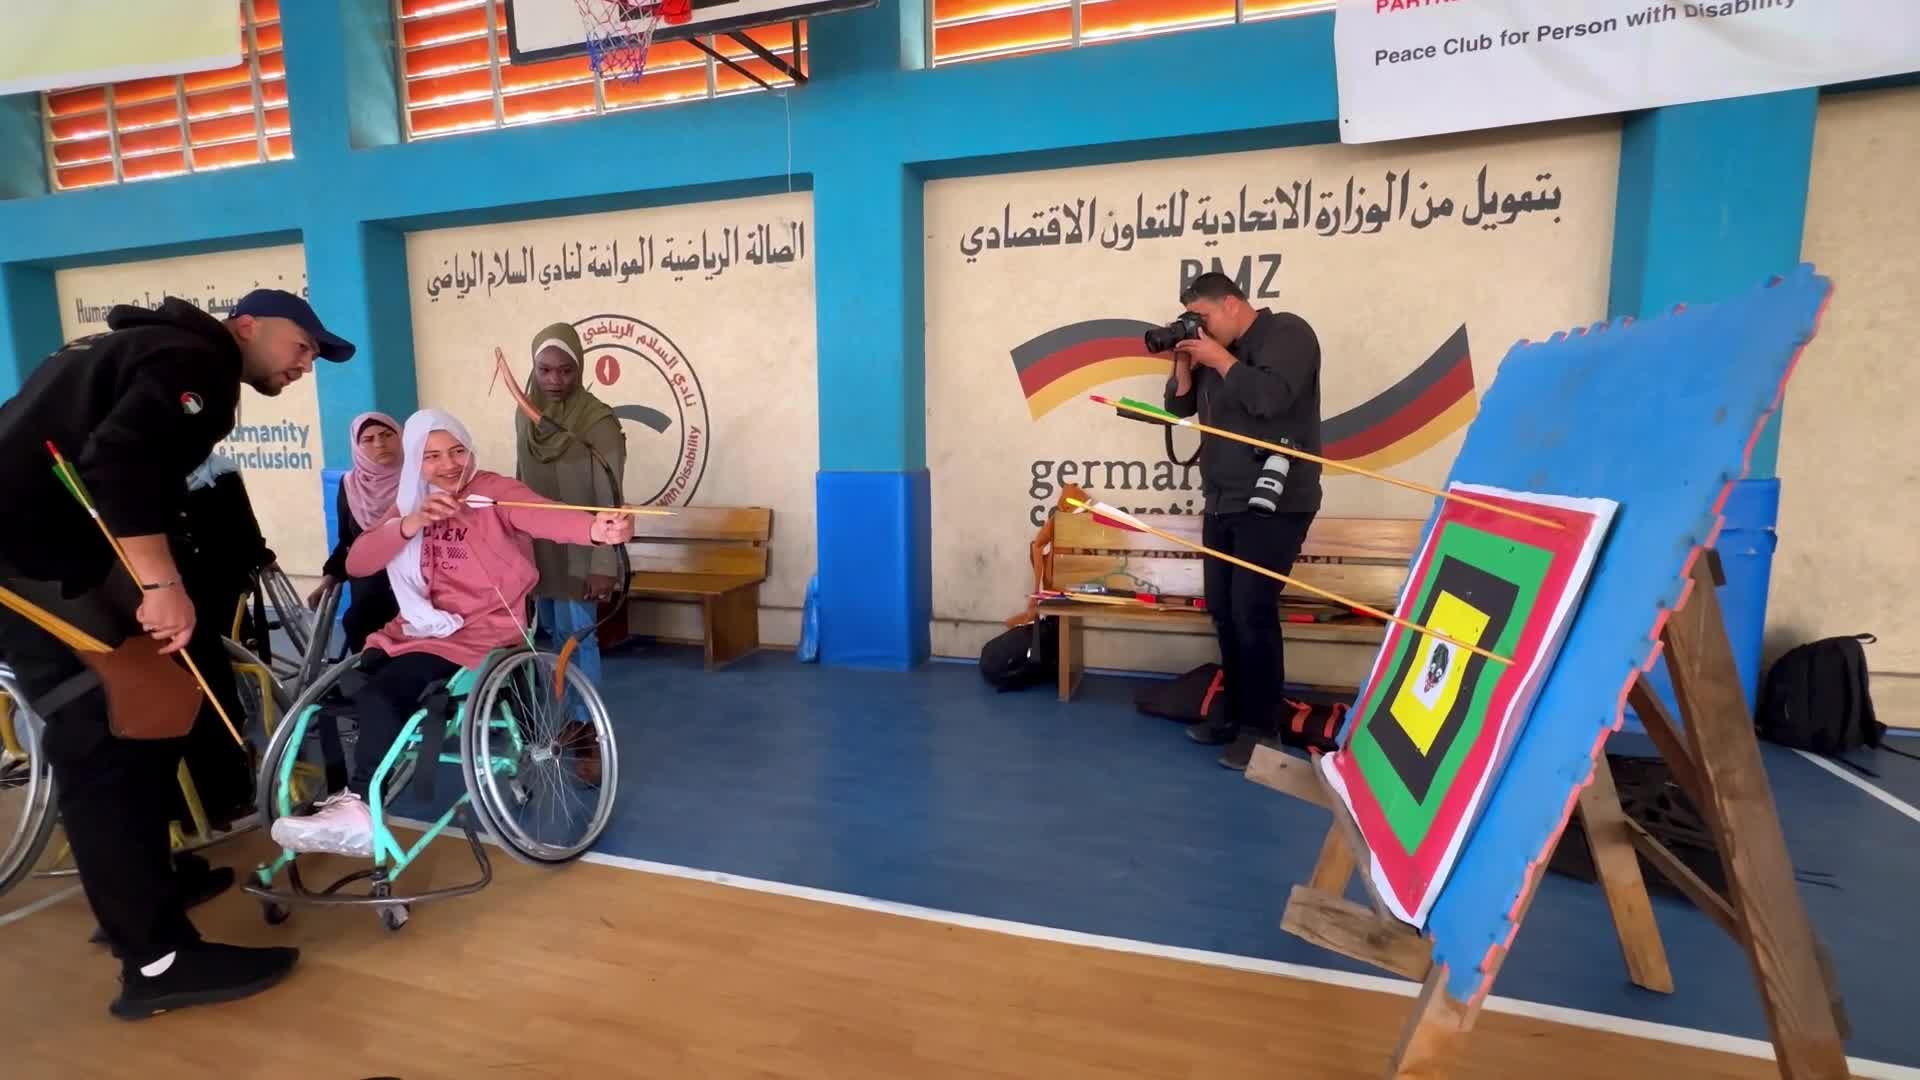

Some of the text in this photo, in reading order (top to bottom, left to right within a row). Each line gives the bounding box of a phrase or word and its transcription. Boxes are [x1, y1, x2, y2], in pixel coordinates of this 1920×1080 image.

[1375, 49, 1436, 66] Peace
[1443, 34, 1492, 56] Club
[1500, 30, 1530, 47] for
[1537, 19, 1617, 42] Person
[1626, 4, 1676, 28] with
[960, 164, 1562, 263] بتمويل من الوزارة الاتحادية للتعاون الاقتصادي
[538, 241, 582, 291] لنادي
[660, 225, 739, 282] الرياضية
[745, 221, 805, 266] الصالة
[427, 249, 484, 303] الرياضي
[487, 245, 535, 297] السلام
[582, 320, 635, 345] الرياضي
[224, 419, 310, 448] umanity
[675, 425, 702, 489] Disability
